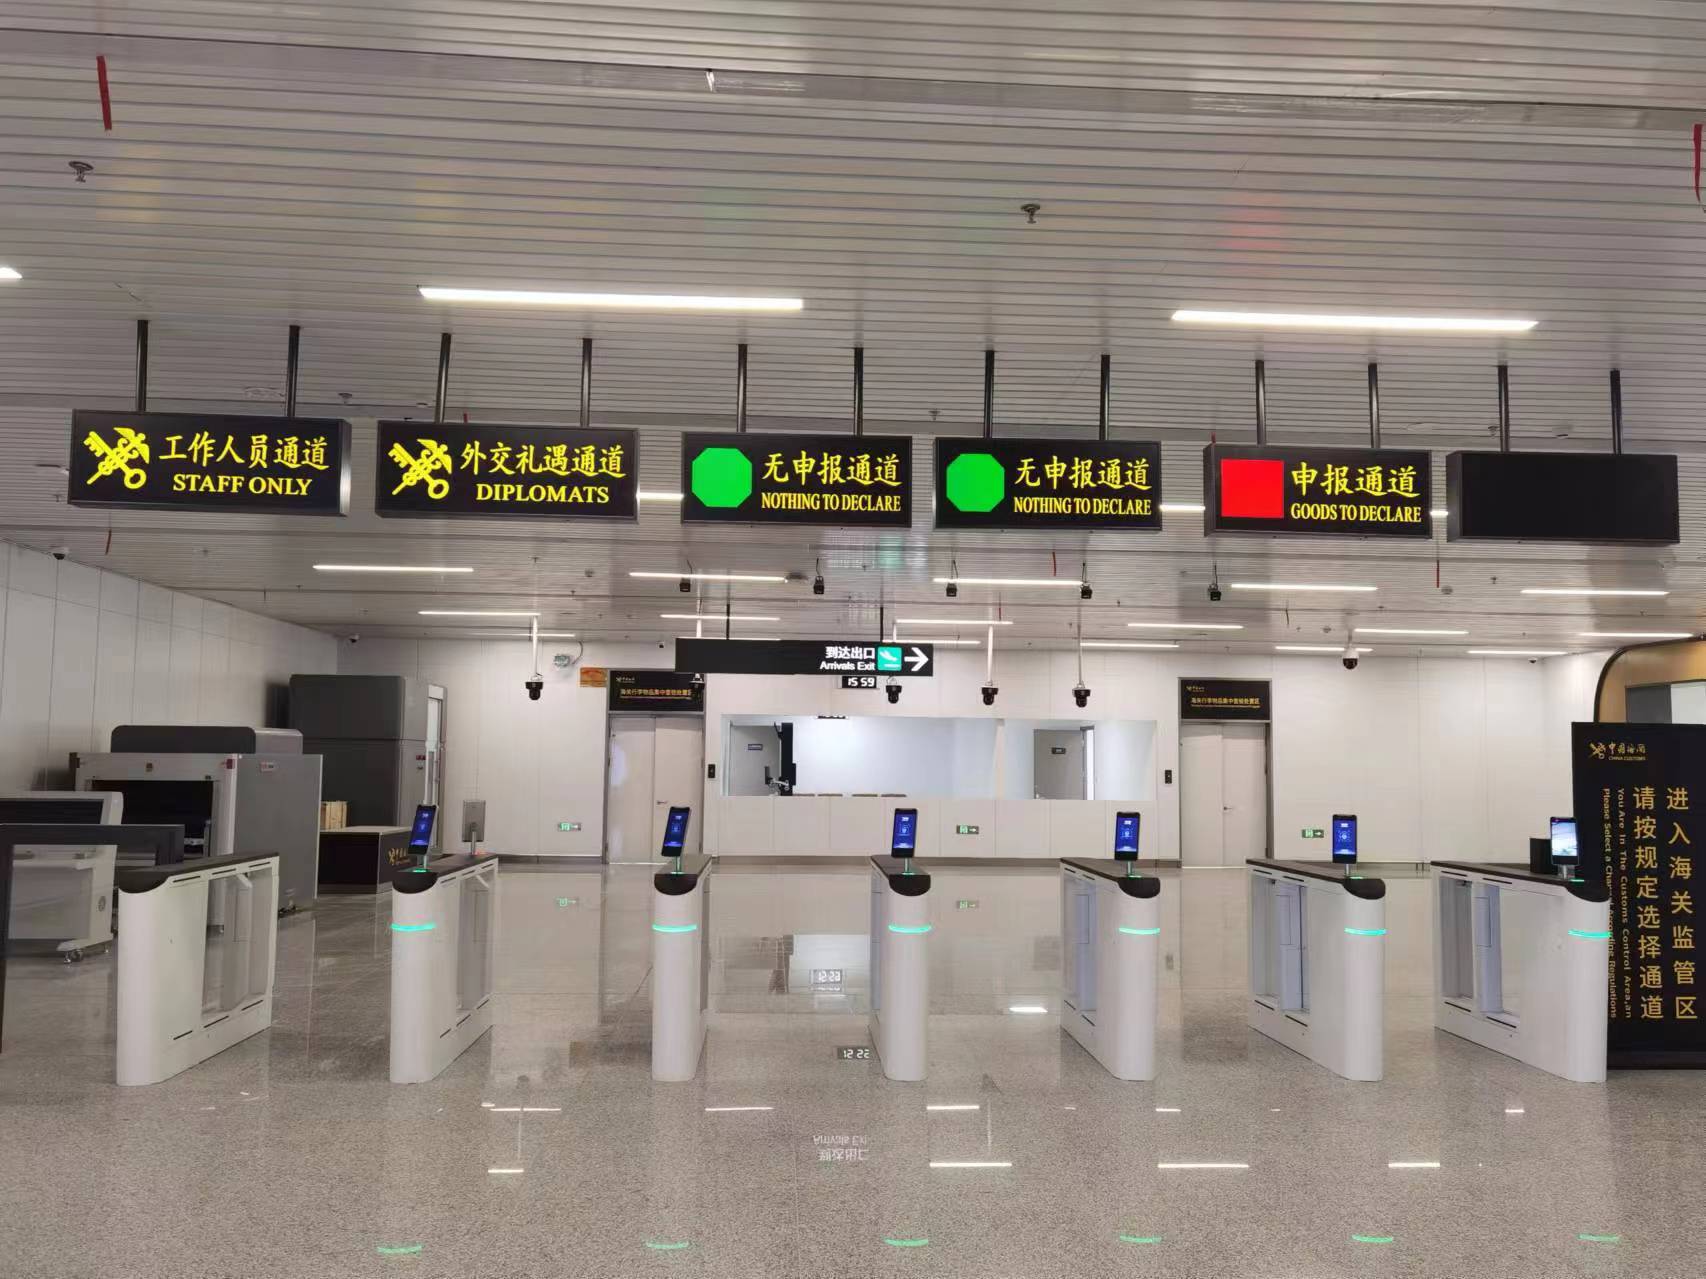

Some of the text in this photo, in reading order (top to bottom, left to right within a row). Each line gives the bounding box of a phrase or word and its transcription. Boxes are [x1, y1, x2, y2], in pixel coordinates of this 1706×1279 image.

[158, 431, 330, 470] 工作人员通道
[460, 440, 627, 479] 外交礼遇通道
[762, 450, 903, 487] 无申报通道
[1014, 455, 1152, 490] 无申报通道
[1291, 461, 1421, 498] 申报通道
[173, 474, 313, 496] STAFF ONLY
[475, 483, 610, 504] DIPLOMATS
[761, 492, 901, 512] NOTHING TO DECLARE
[1014, 497, 1152, 515] NOTHING TO DECLARE
[1291, 502, 1421, 522] GOODS TO DECLARE
[819, 660, 876, 671] Arrivals Exit
[825, 646, 876, 660] 到达出口
[1603, 788, 1611, 820] Please
[1617, 788, 1625, 808] You
[1618, 810, 1626, 830] Are
[1604, 823, 1612, 852] Select
[1619, 834, 1626, 845] In
[1620, 875, 1629, 923] Customs
[1633, 787, 1664, 1019] 请按规定选择通道
[1666, 787, 1698, 1019] 进入海关监管区
[1622, 928, 1632, 970] Control
